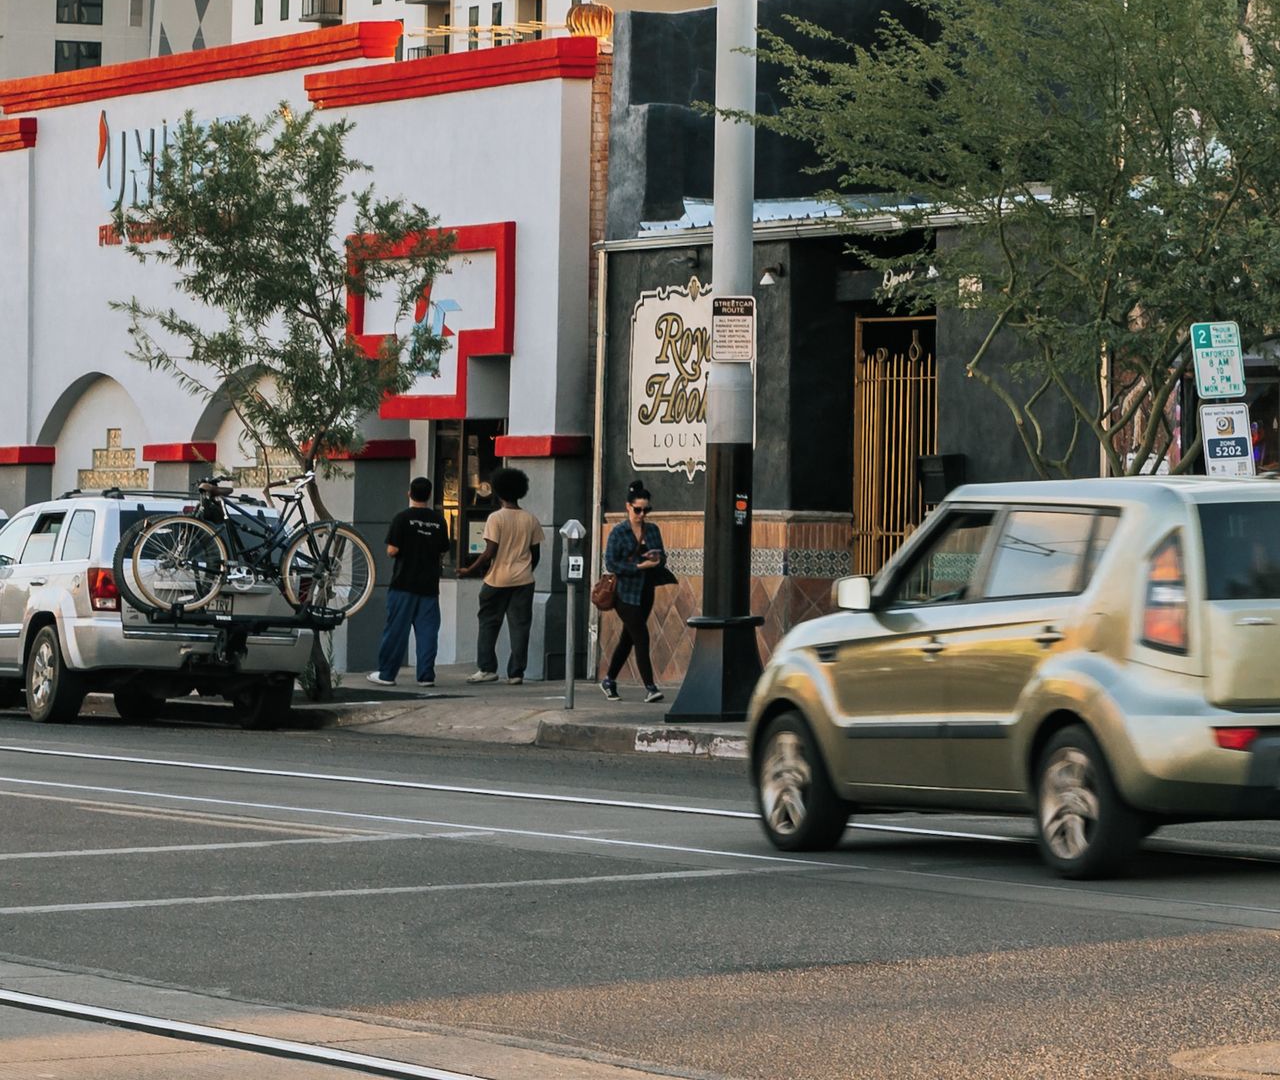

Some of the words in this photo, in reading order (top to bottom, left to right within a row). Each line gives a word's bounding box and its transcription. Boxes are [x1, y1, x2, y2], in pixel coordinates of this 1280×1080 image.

[1198, 329, 1207, 344] 2
[655, 312, 711, 381] Roy
[1202, 350, 1235, 358] ENFORCED
[1211, 376, 1216, 384] 5
[1220, 375, 1231, 383] PM
[653, 433, 702, 448] LOUN
[1216, 446, 1242, 456] 5202
